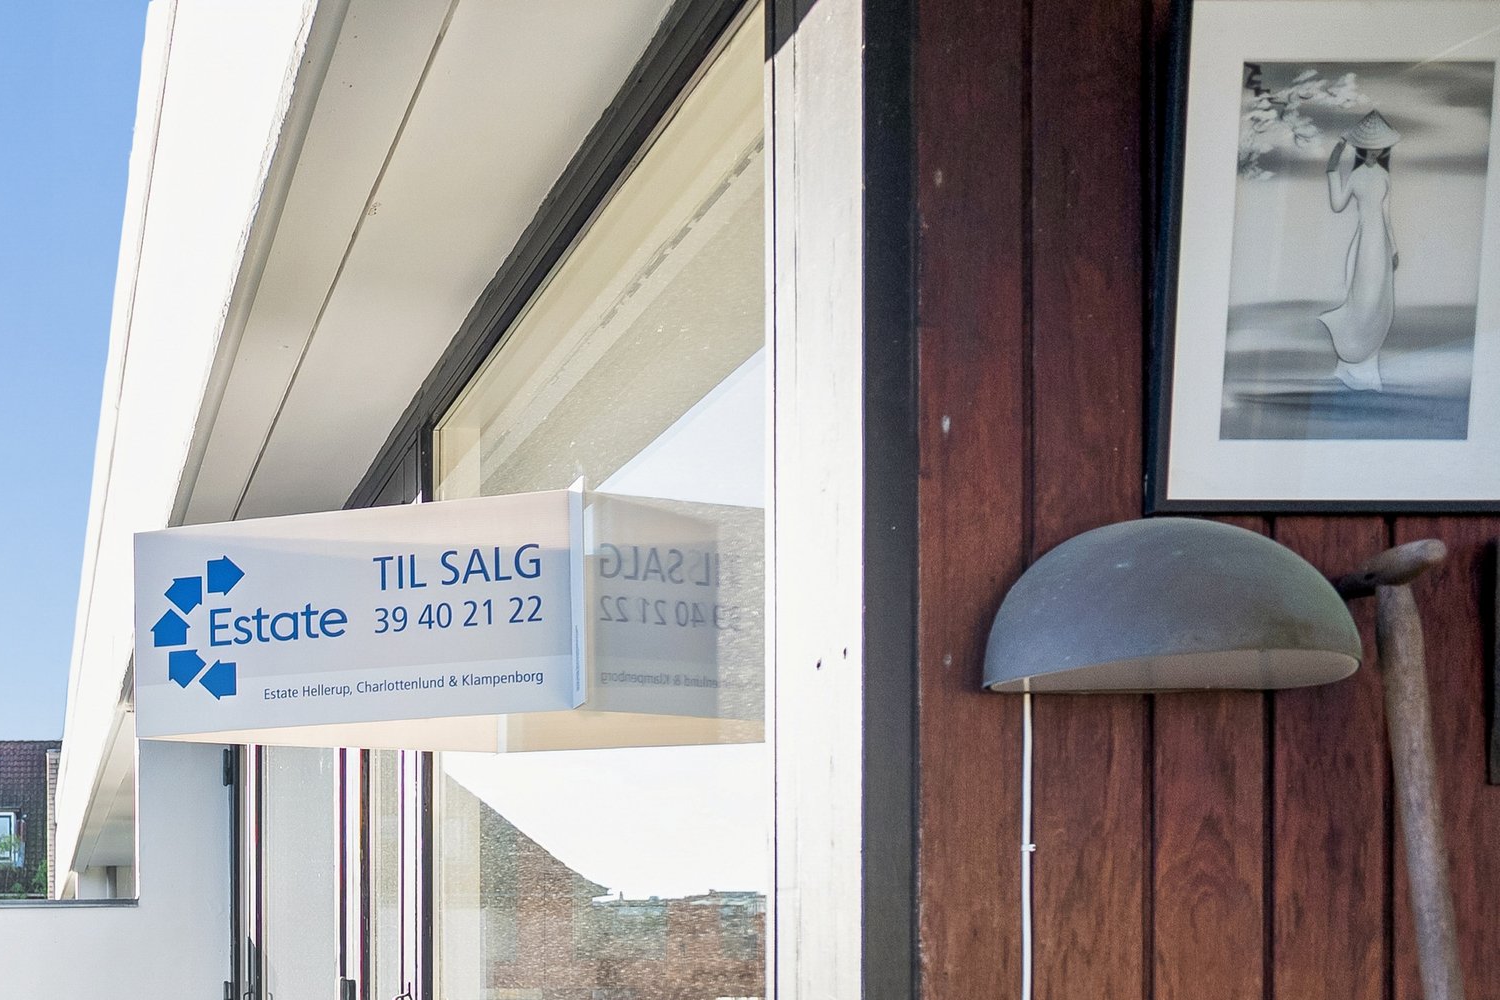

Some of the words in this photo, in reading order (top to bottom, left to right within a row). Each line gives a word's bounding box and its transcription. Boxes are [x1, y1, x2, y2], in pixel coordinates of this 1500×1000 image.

[373, 554, 427, 591] TIL
[440, 543, 542, 586] SALG
[209, 602, 348, 648] Estate
[374, 606, 408, 634] 39
[418, 602, 452, 630] 40
[463, 598, 493, 627] 21
[508, 595, 543, 624] 22
[263, 686, 299, 700] Estate
[302, 683, 353, 698] Hellerup,
[356, 676, 445, 694] Charlottenlund
[449, 675, 458, 688] &
[462, 670, 544, 688] Klampenborg
